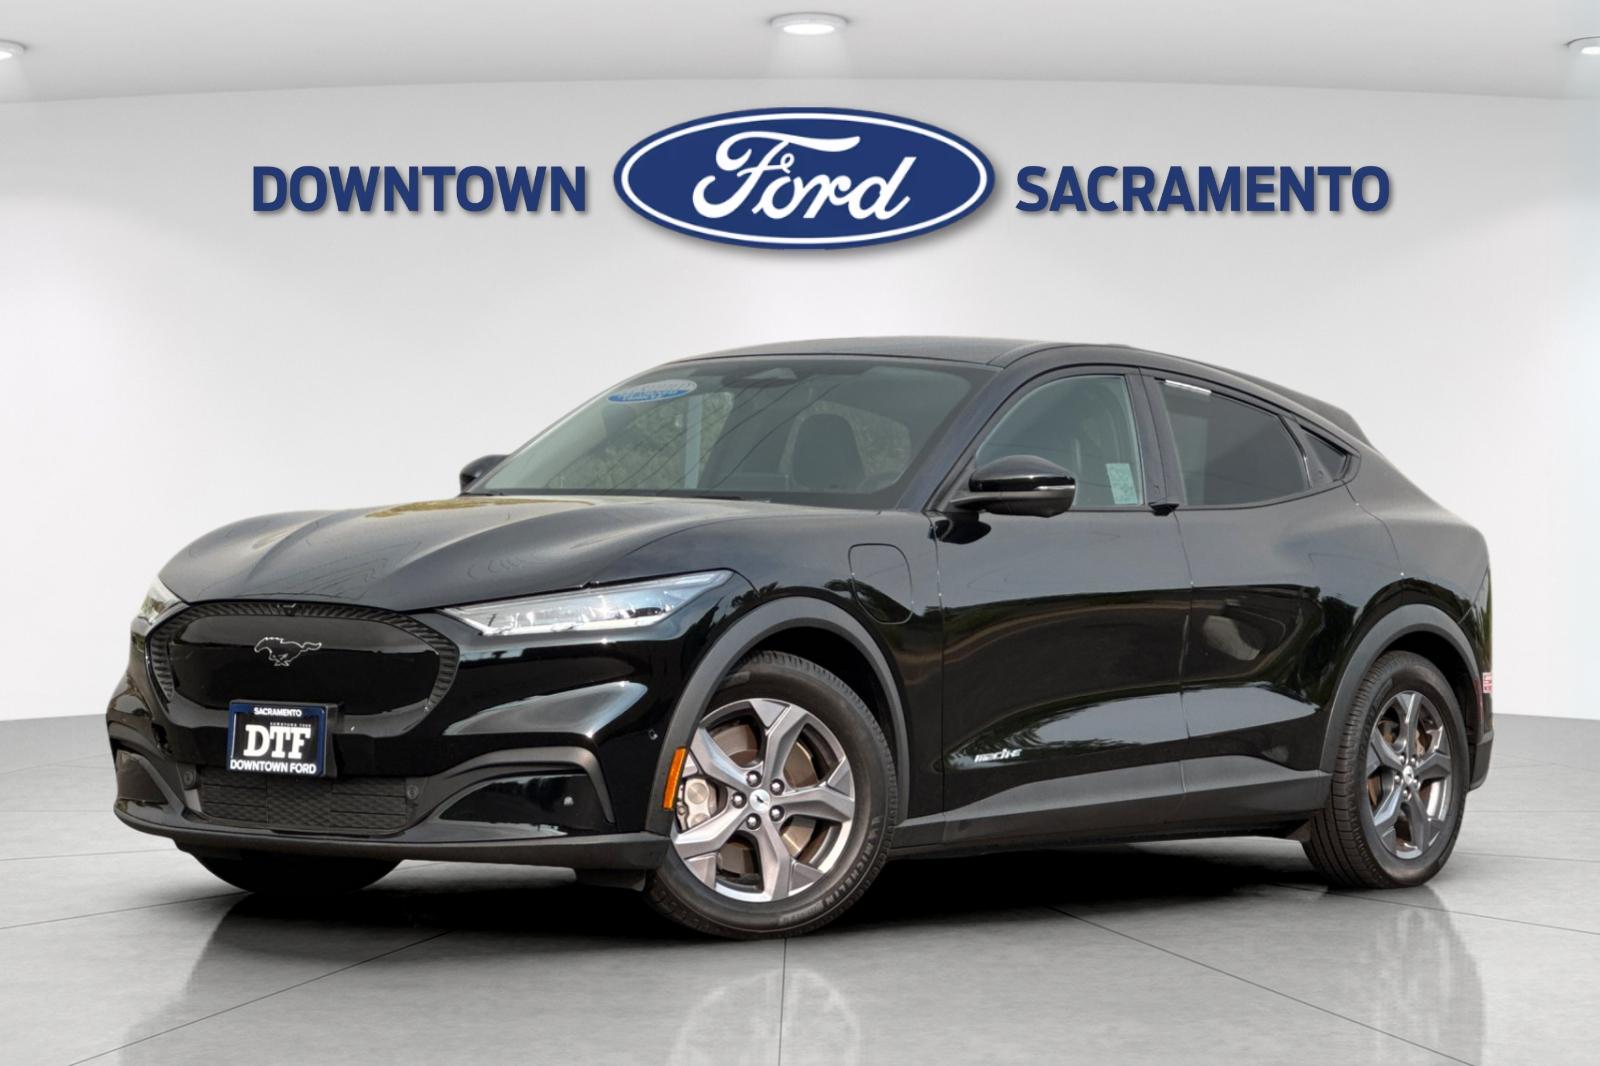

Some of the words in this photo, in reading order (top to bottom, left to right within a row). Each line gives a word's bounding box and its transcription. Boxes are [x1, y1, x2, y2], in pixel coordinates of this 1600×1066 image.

[252, 166, 586, 213] DOWNTOWN
[692, 131, 917, 220] Ford
[1015, 165, 1390, 212] SACRAMENTO
[253, 707, 303, 717] SACRAMENTO
[243, 724, 312, 759] DTF
[230, 760, 288, 773] DOWNTOWN
[289, 763, 317, 774] FORD
